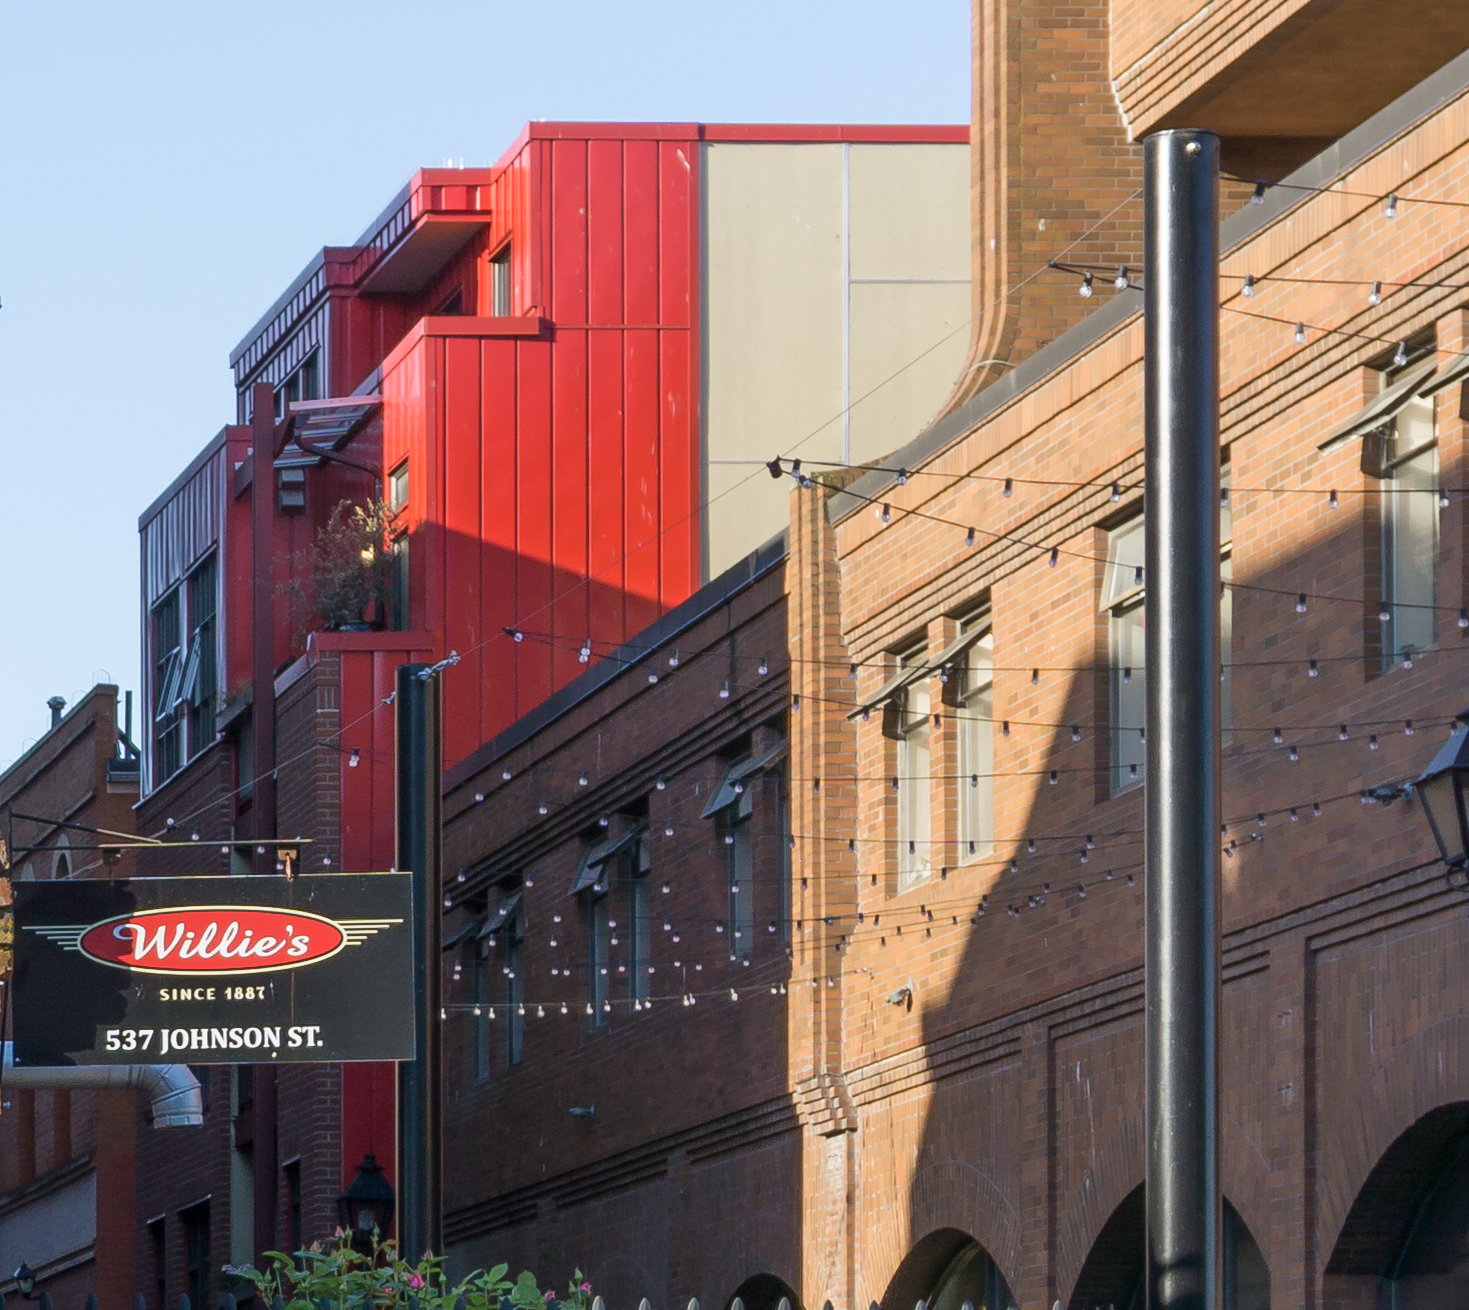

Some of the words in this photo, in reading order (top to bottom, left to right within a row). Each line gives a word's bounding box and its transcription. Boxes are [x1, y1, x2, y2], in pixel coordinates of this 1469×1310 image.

[113, 920, 311, 961] Willie's
[159, 987, 217, 1001] SINCE
[223, 986, 266, 1000] 1887
[105, 1028, 154, 1051] 537
[159, 1026, 282, 1055] JOHNSON
[286, 1025, 324, 1048] ST.
